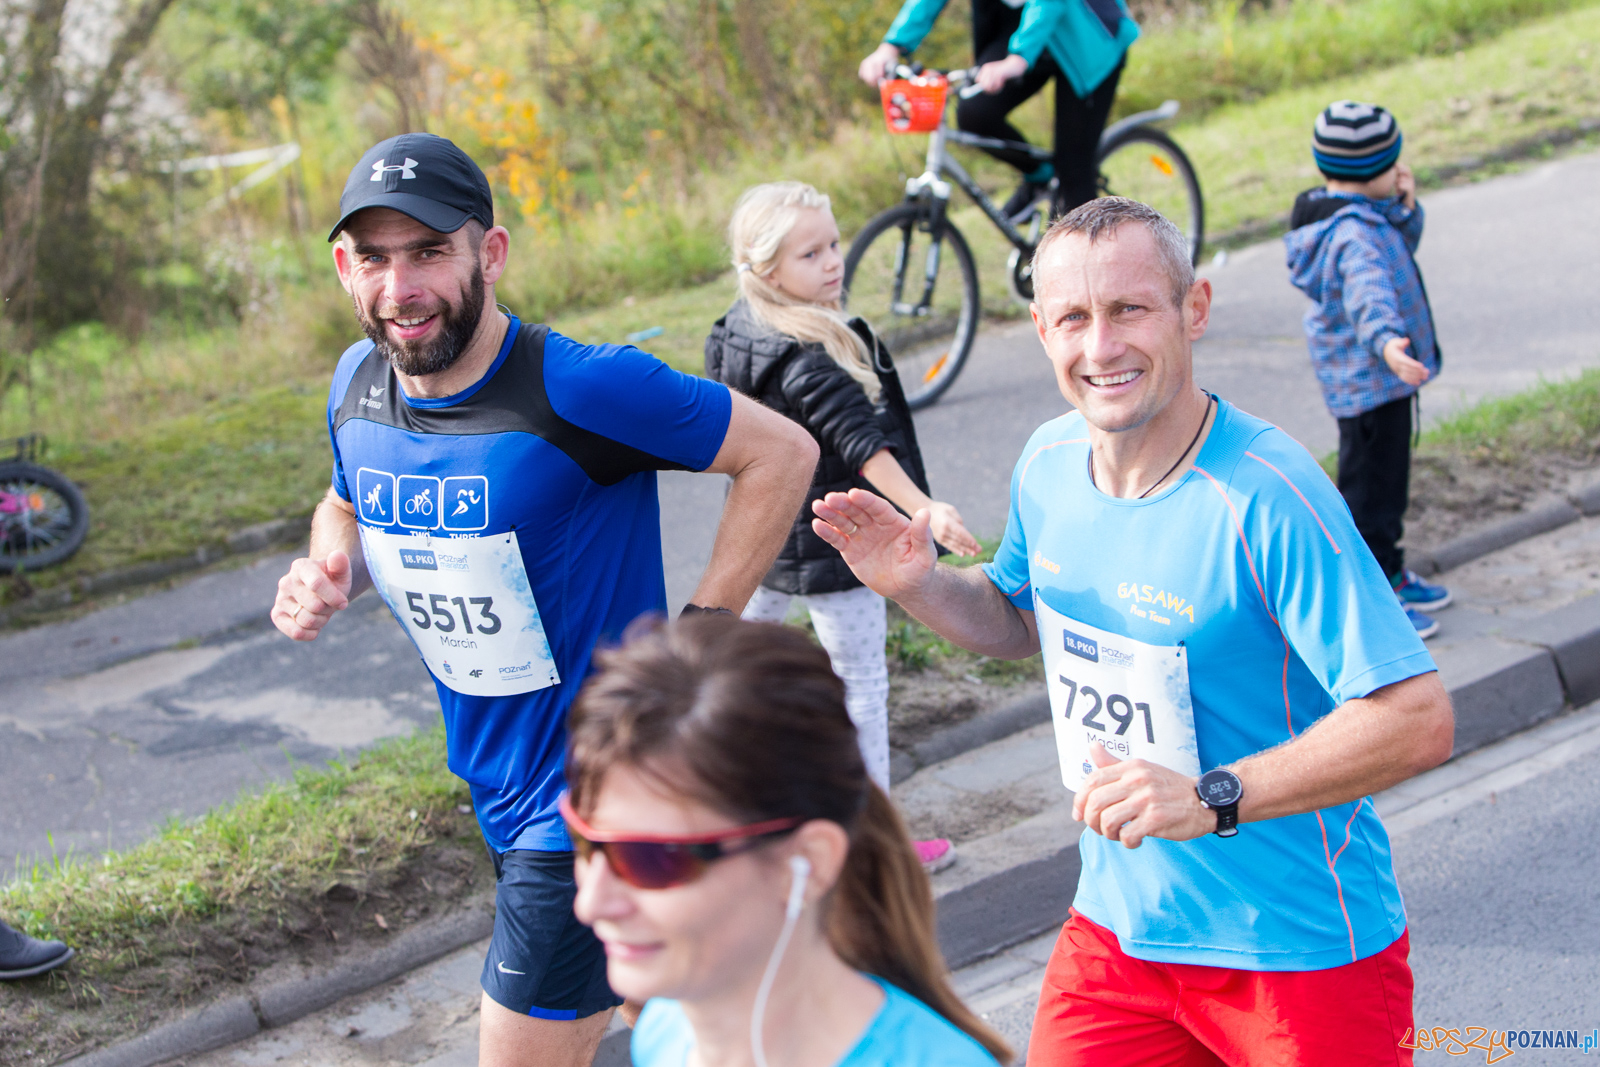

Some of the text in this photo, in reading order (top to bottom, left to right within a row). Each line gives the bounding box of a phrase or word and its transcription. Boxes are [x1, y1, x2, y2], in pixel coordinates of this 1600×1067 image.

[359, 397, 382, 410] erima
[403, 554, 434, 565] 18.PKO
[405, 591, 502, 635] 5513
[1130, 604, 1171, 626] Run Team
[440, 635, 478, 650] Marcin
[1059, 674, 1155, 744] 7291
[1087, 732, 1130, 756] Maciej
